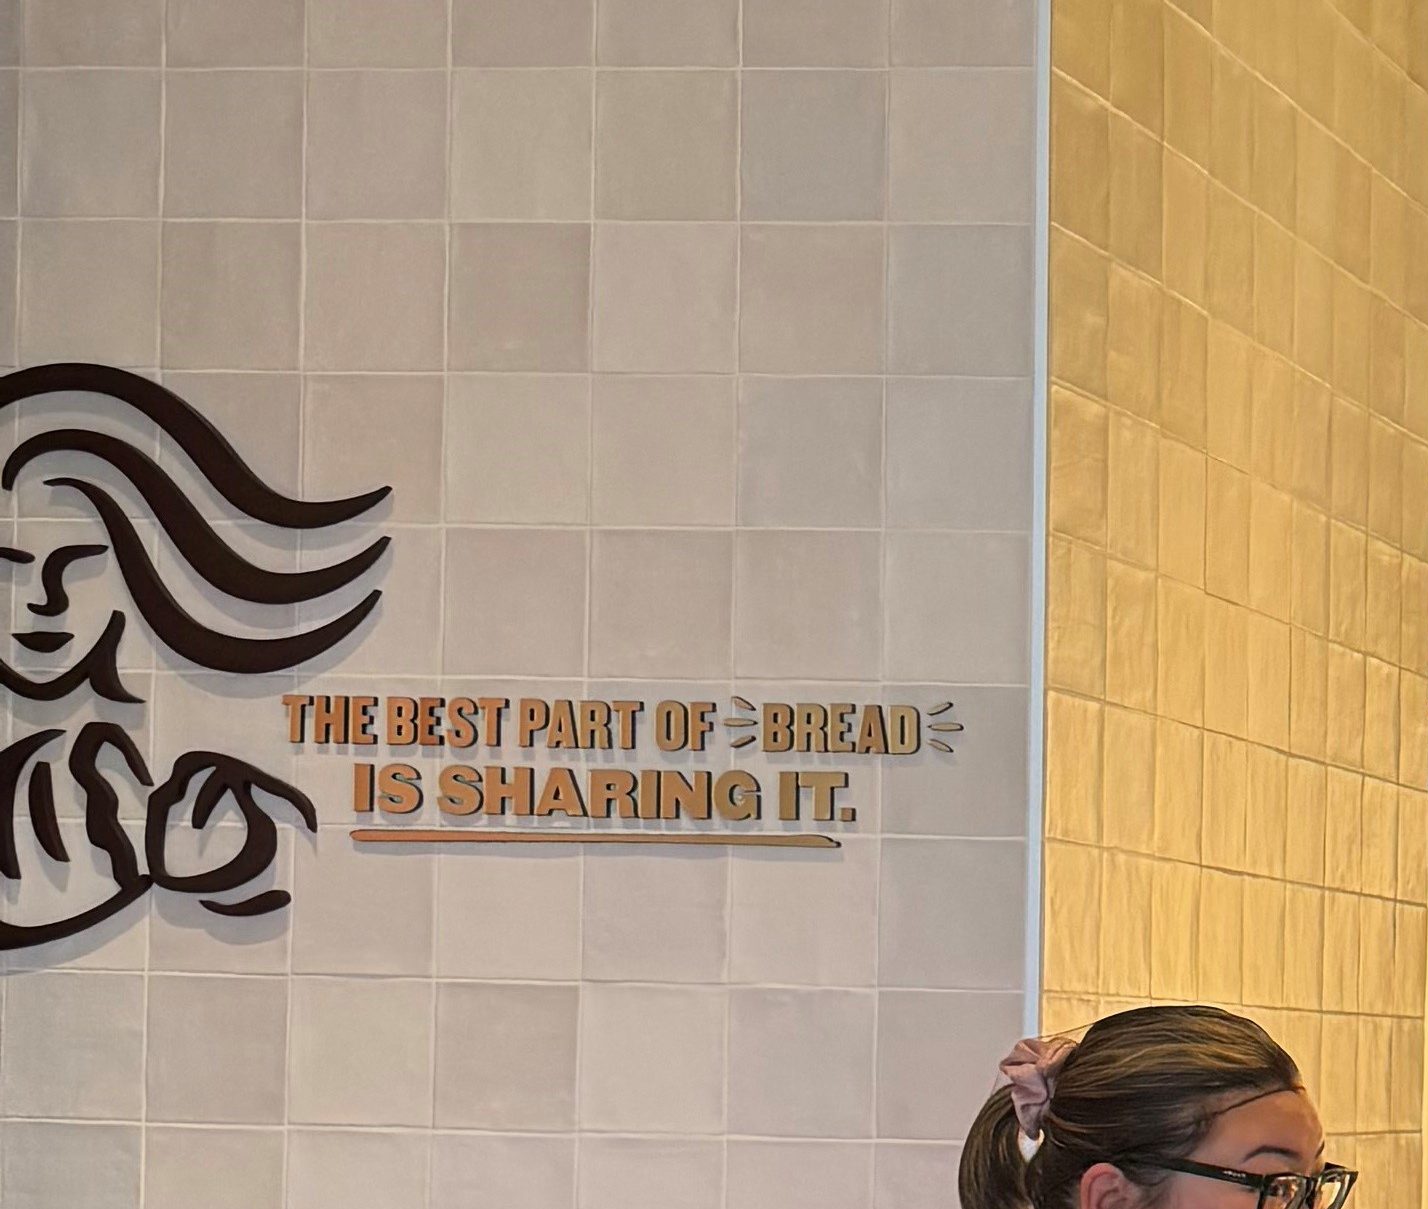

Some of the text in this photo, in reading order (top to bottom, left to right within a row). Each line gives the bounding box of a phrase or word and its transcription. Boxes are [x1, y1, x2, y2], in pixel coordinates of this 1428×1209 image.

[280, 692, 923, 756] THE BEST PART OF BREAD
[352, 762, 858, 824] IS SHARING IT.
